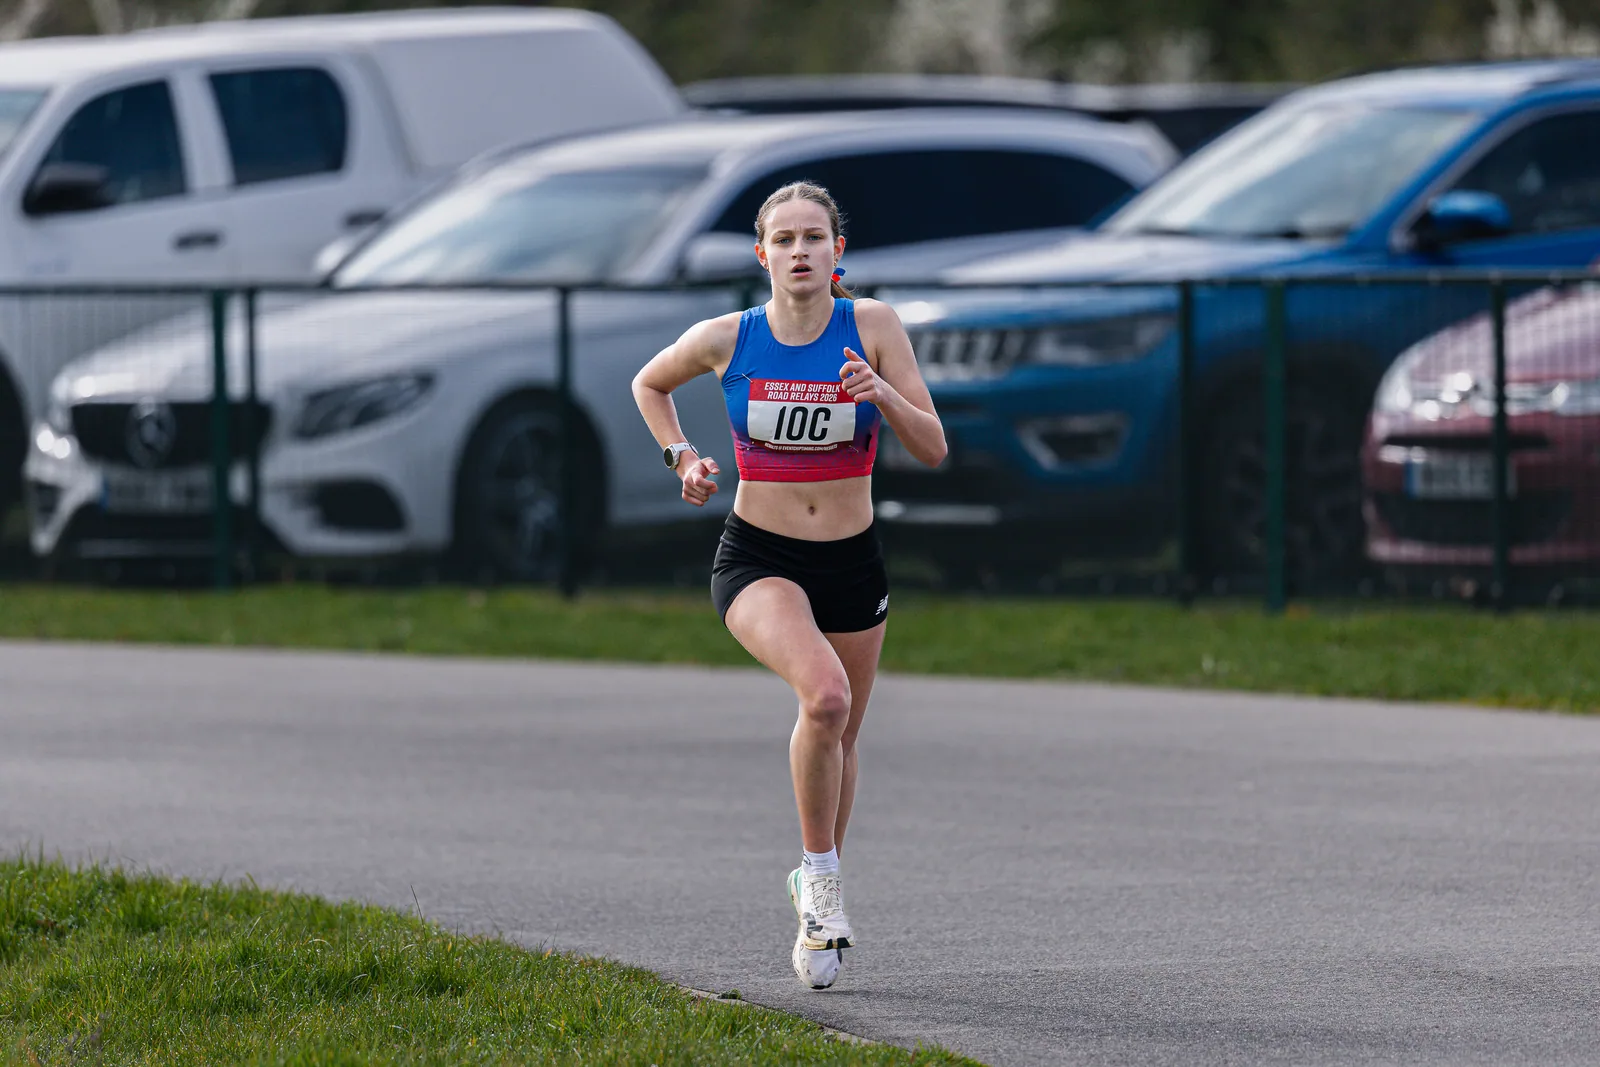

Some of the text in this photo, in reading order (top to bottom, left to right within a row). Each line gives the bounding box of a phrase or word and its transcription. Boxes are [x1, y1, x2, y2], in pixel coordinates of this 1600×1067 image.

[764, 382, 841, 393] ESSEX AND SUFFOLK
[767, 391, 838, 402] ROAD RELAYS 2026
